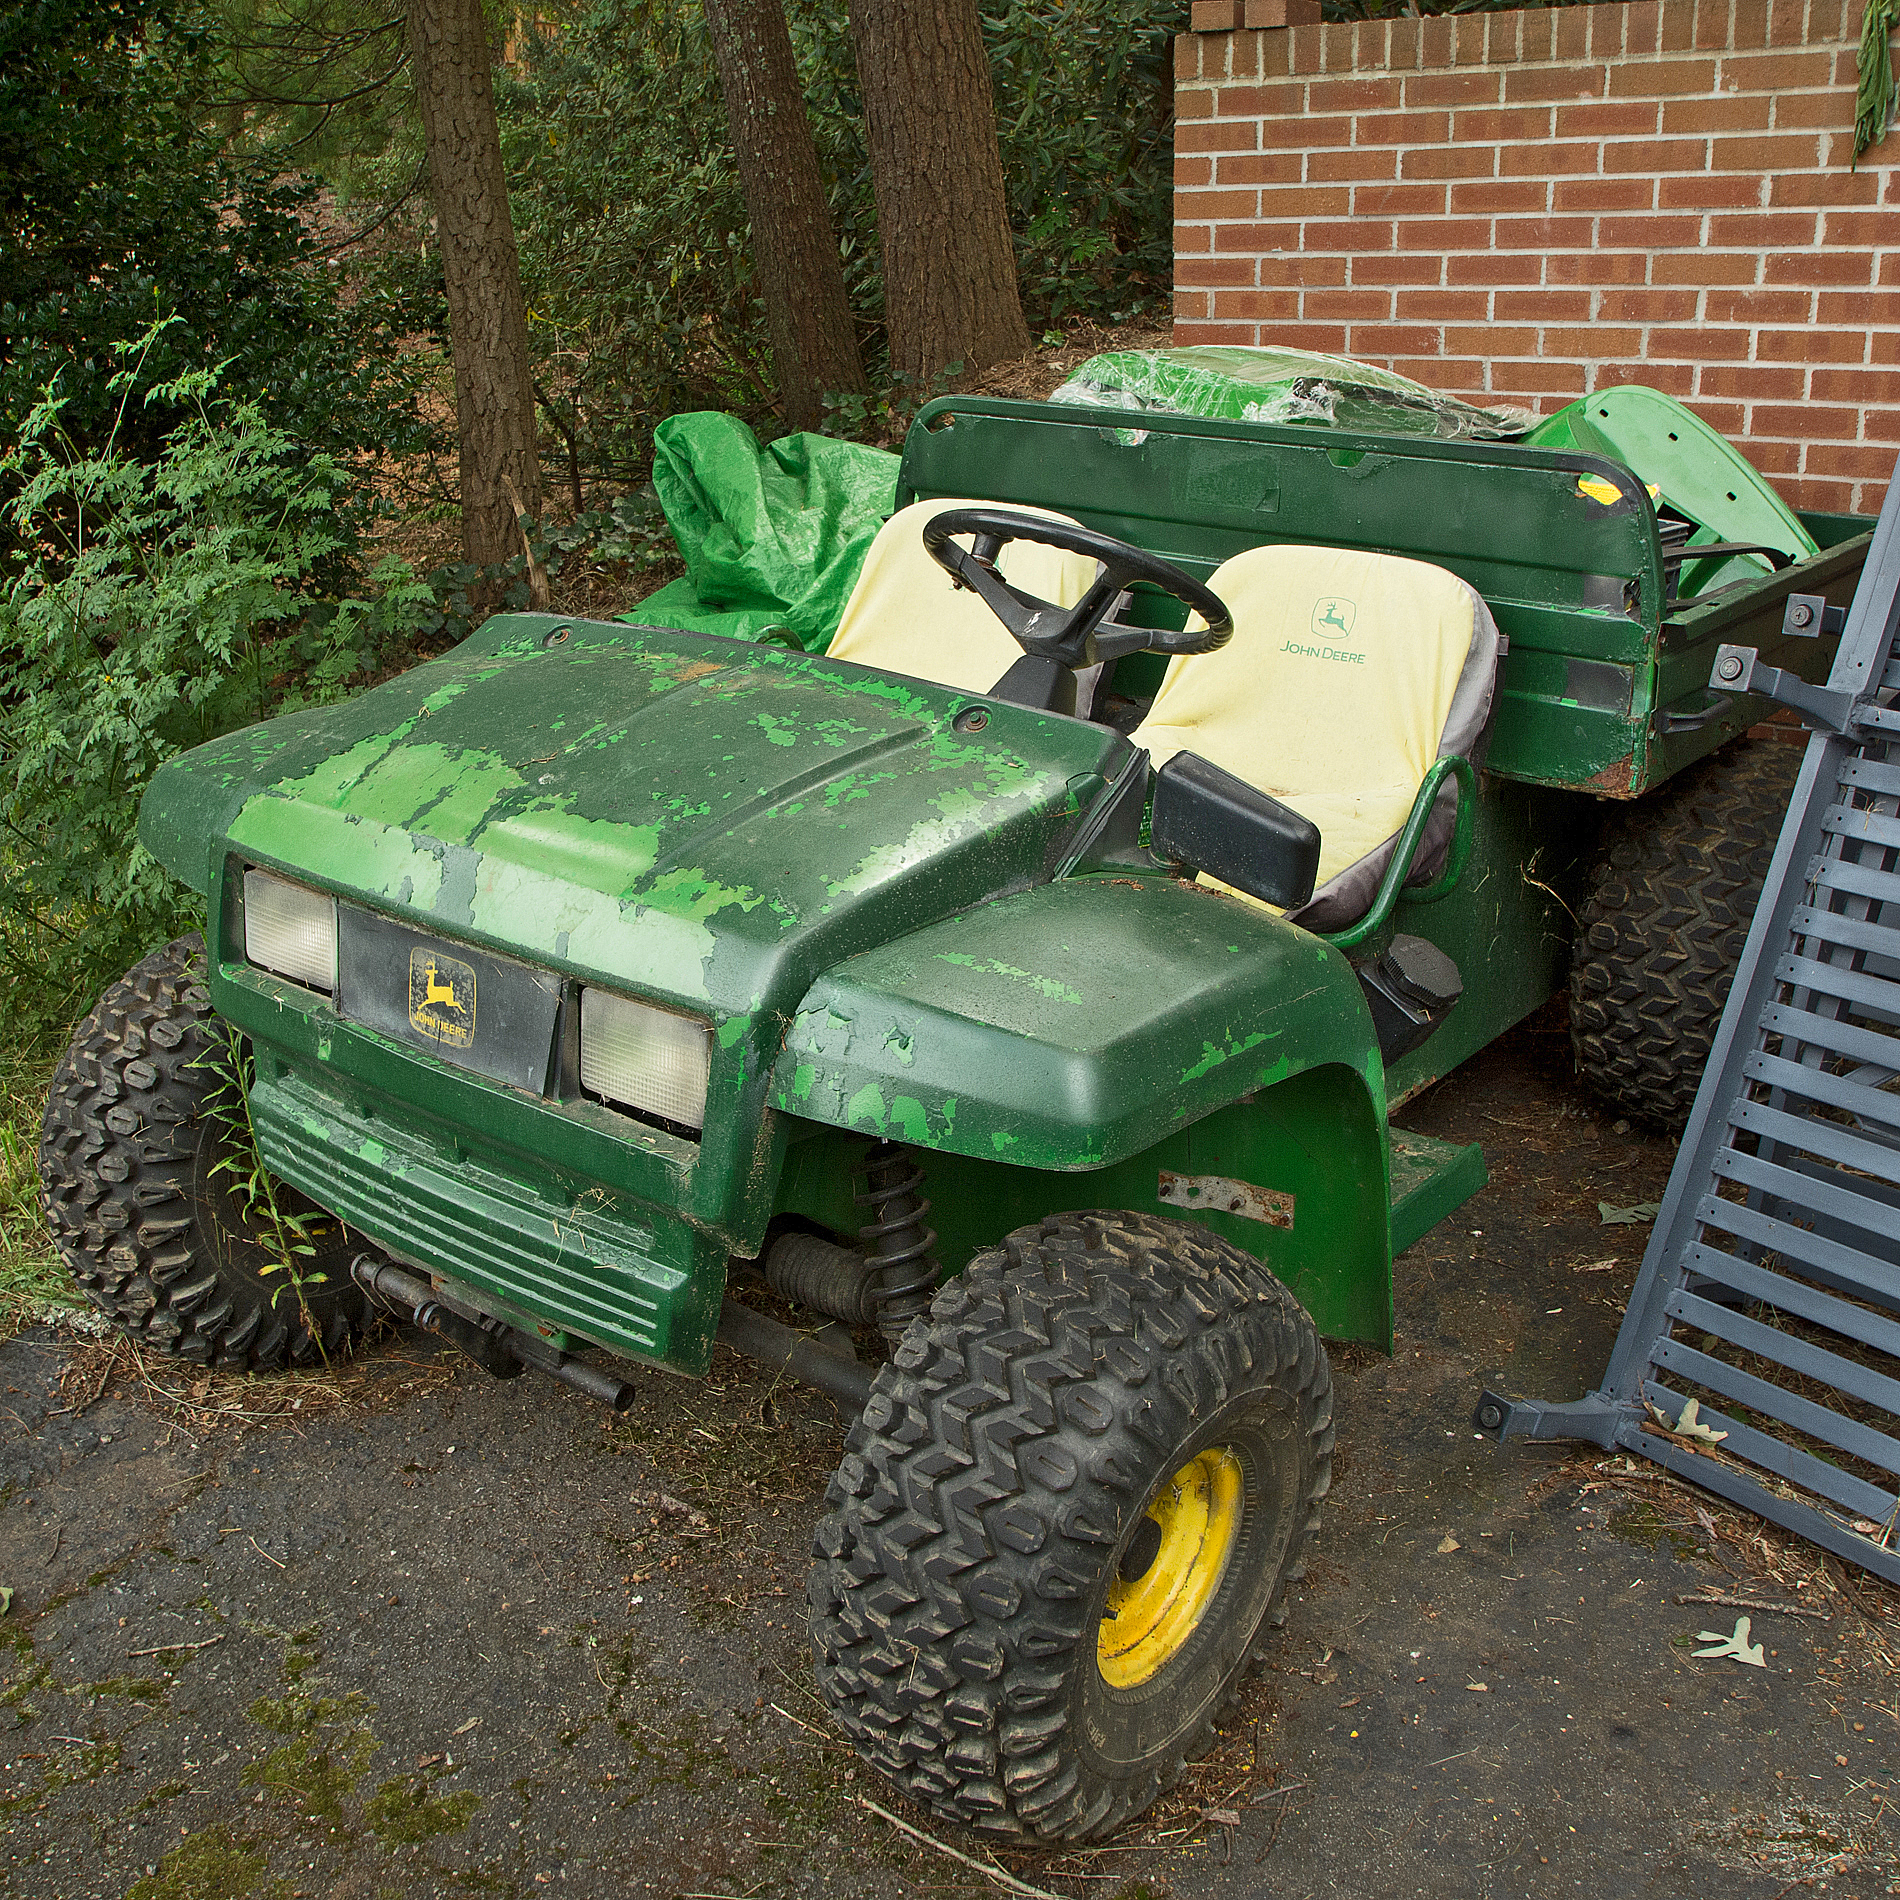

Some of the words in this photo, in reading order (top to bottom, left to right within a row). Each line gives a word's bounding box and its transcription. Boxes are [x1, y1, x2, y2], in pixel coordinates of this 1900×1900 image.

[1279, 640, 1321, 658] JOHN
[1321, 647, 1366, 665] DEERE
[414, 1011, 436, 1028] JOHN
[437, 1020, 468, 1039] DEERE
